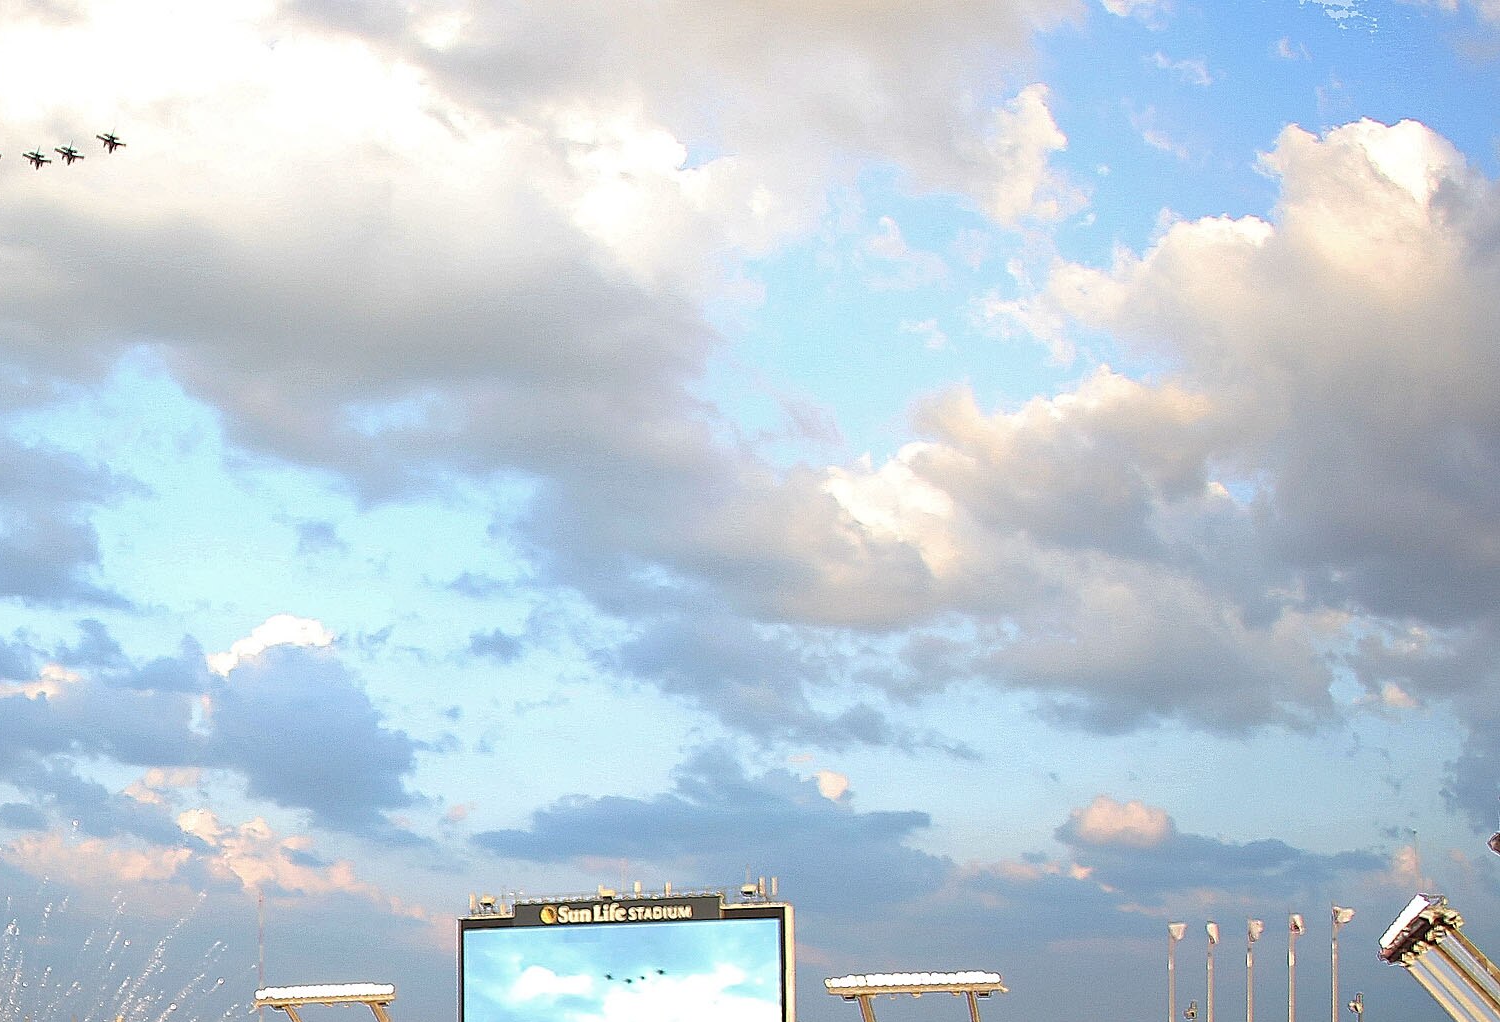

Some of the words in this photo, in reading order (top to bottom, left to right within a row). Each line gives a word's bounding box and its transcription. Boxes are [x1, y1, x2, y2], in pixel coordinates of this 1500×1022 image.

[557, 905, 592, 923] Sun
[593, 903, 627, 922] Life
[627, 905, 693, 921] STADIUM
